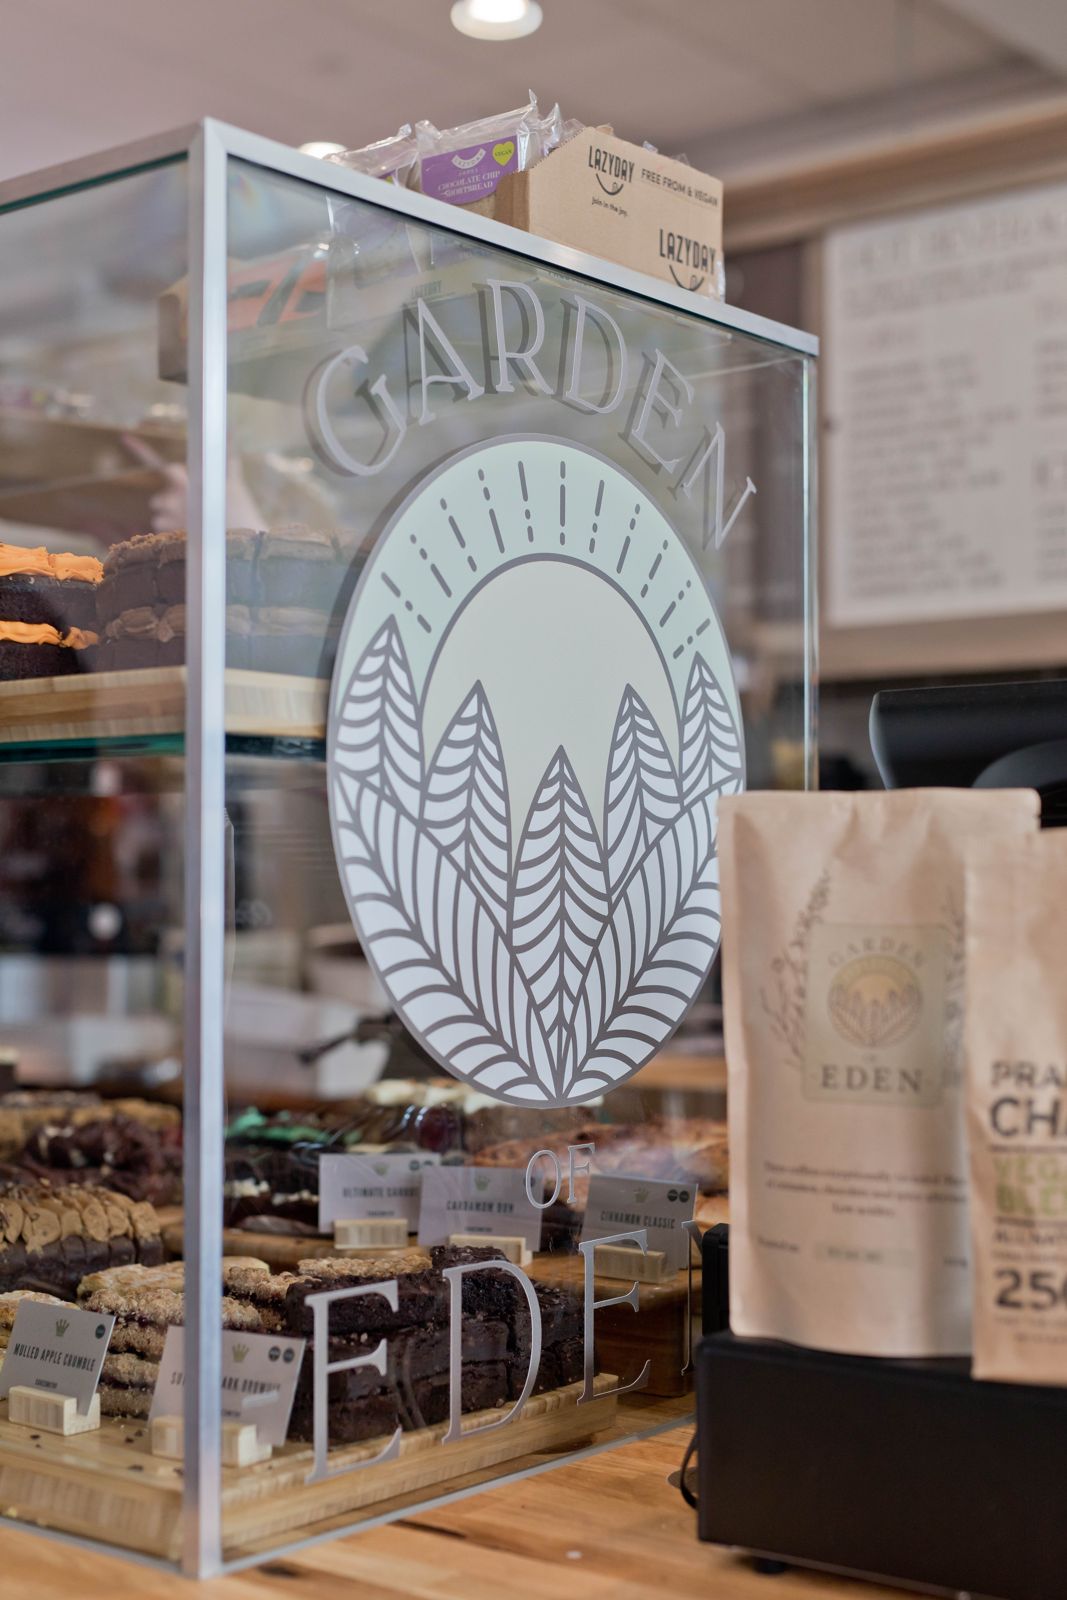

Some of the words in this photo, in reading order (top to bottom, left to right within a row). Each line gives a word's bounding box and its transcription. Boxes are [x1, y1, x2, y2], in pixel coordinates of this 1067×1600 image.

[588, 145, 635, 183] LAZYDAY
[641, 168, 661, 185] FREE
[662, 177, 686, 194] FROM
[687, 186, 693, 197] &
[694, 189, 718, 206] VEGAN
[659, 228, 716, 275] LAZYDAY
[315, 278, 757, 550] GARDEN
[821, 1064, 923, 1092] EDEN
[991, 1060, 1067, 1089] PRA
[990, 1097, 1067, 1138] CH
[525, 1142, 596, 1209] OF
[600, 1210, 641, 1225] CINNAMON
[643, 1215, 676, 1230] CLASSIC
[994, 1267, 1067, 1311] 25
[13, 1343, 40, 1360] MULLED
[40, 1348, 62, 1365] APPLE
[62, 1354, 96, 1372] CRUMBLE
[221, 1376, 240, 1391] ARK
